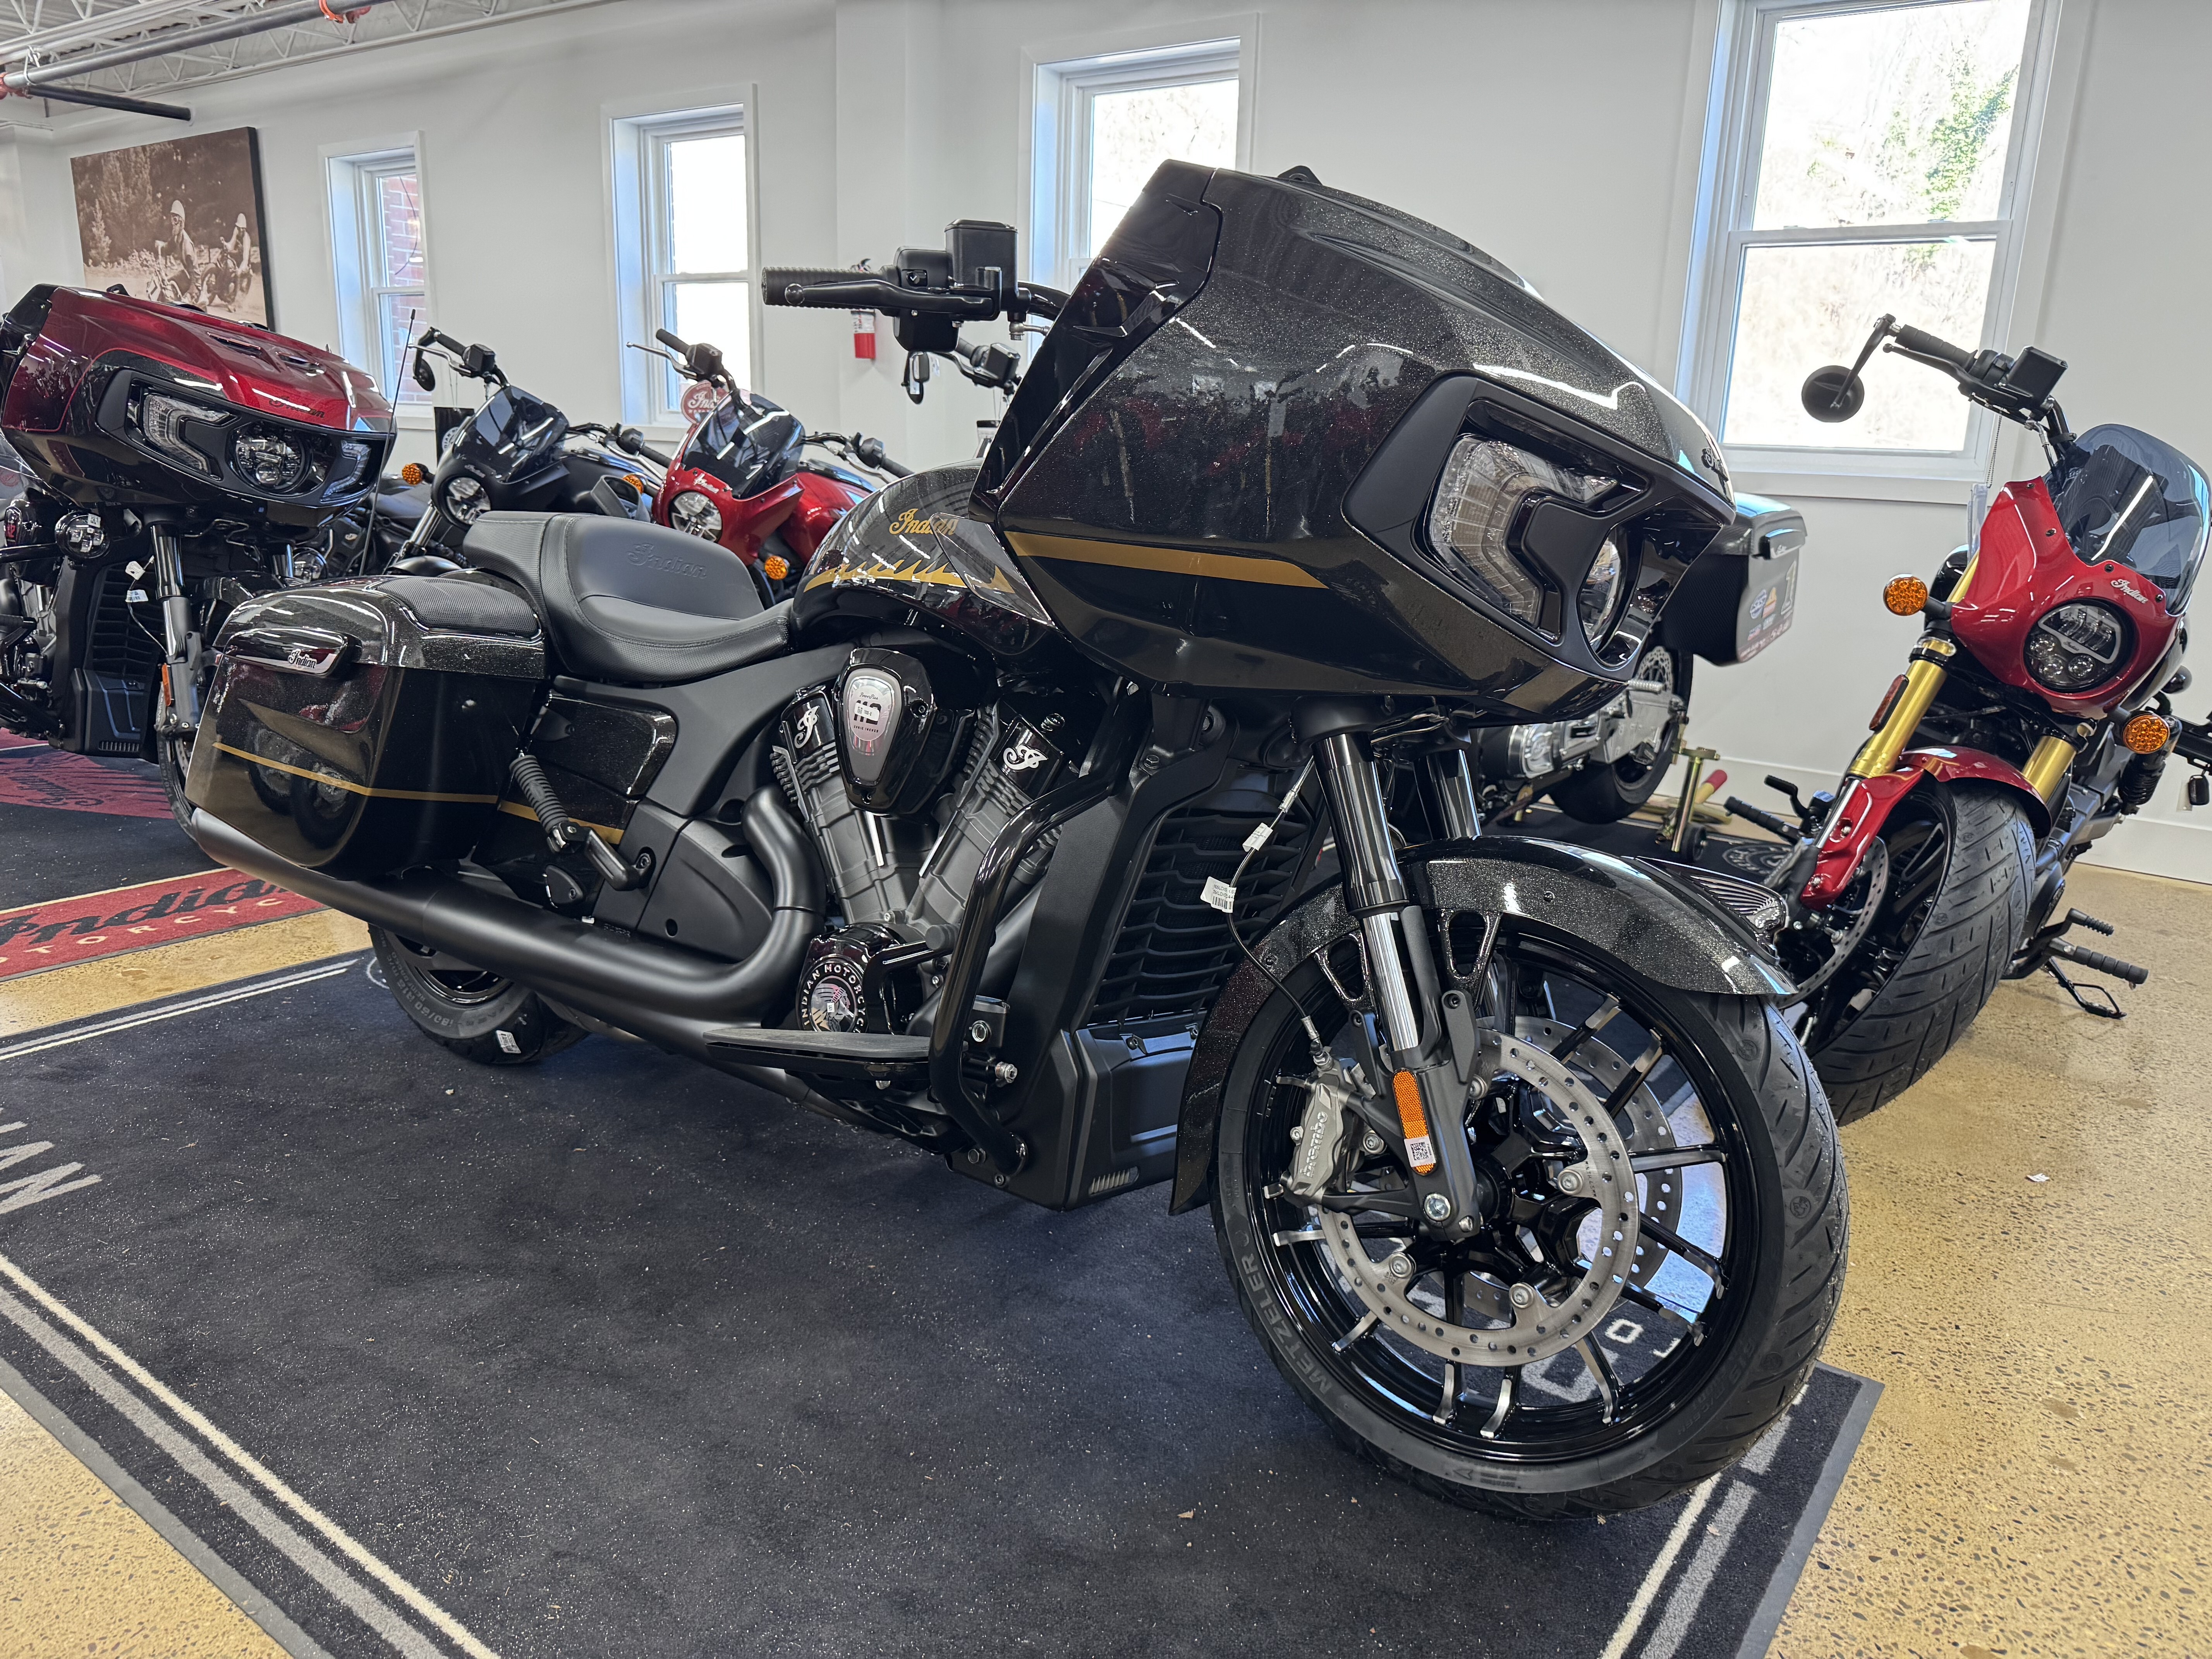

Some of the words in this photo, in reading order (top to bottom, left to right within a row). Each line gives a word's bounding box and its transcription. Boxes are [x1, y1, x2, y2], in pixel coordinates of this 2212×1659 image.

[625, 543, 707, 579] Indian
[2111, 579, 2148, 603] Indian
[288, 648, 317, 669] Indian
[801, 969, 820, 1025] INDIAN
[824, 964, 866, 1033] MOTORCYCL
[1300, 1111, 1328, 1178] brembo
[1241, 1253, 1333, 1395] METZELER
